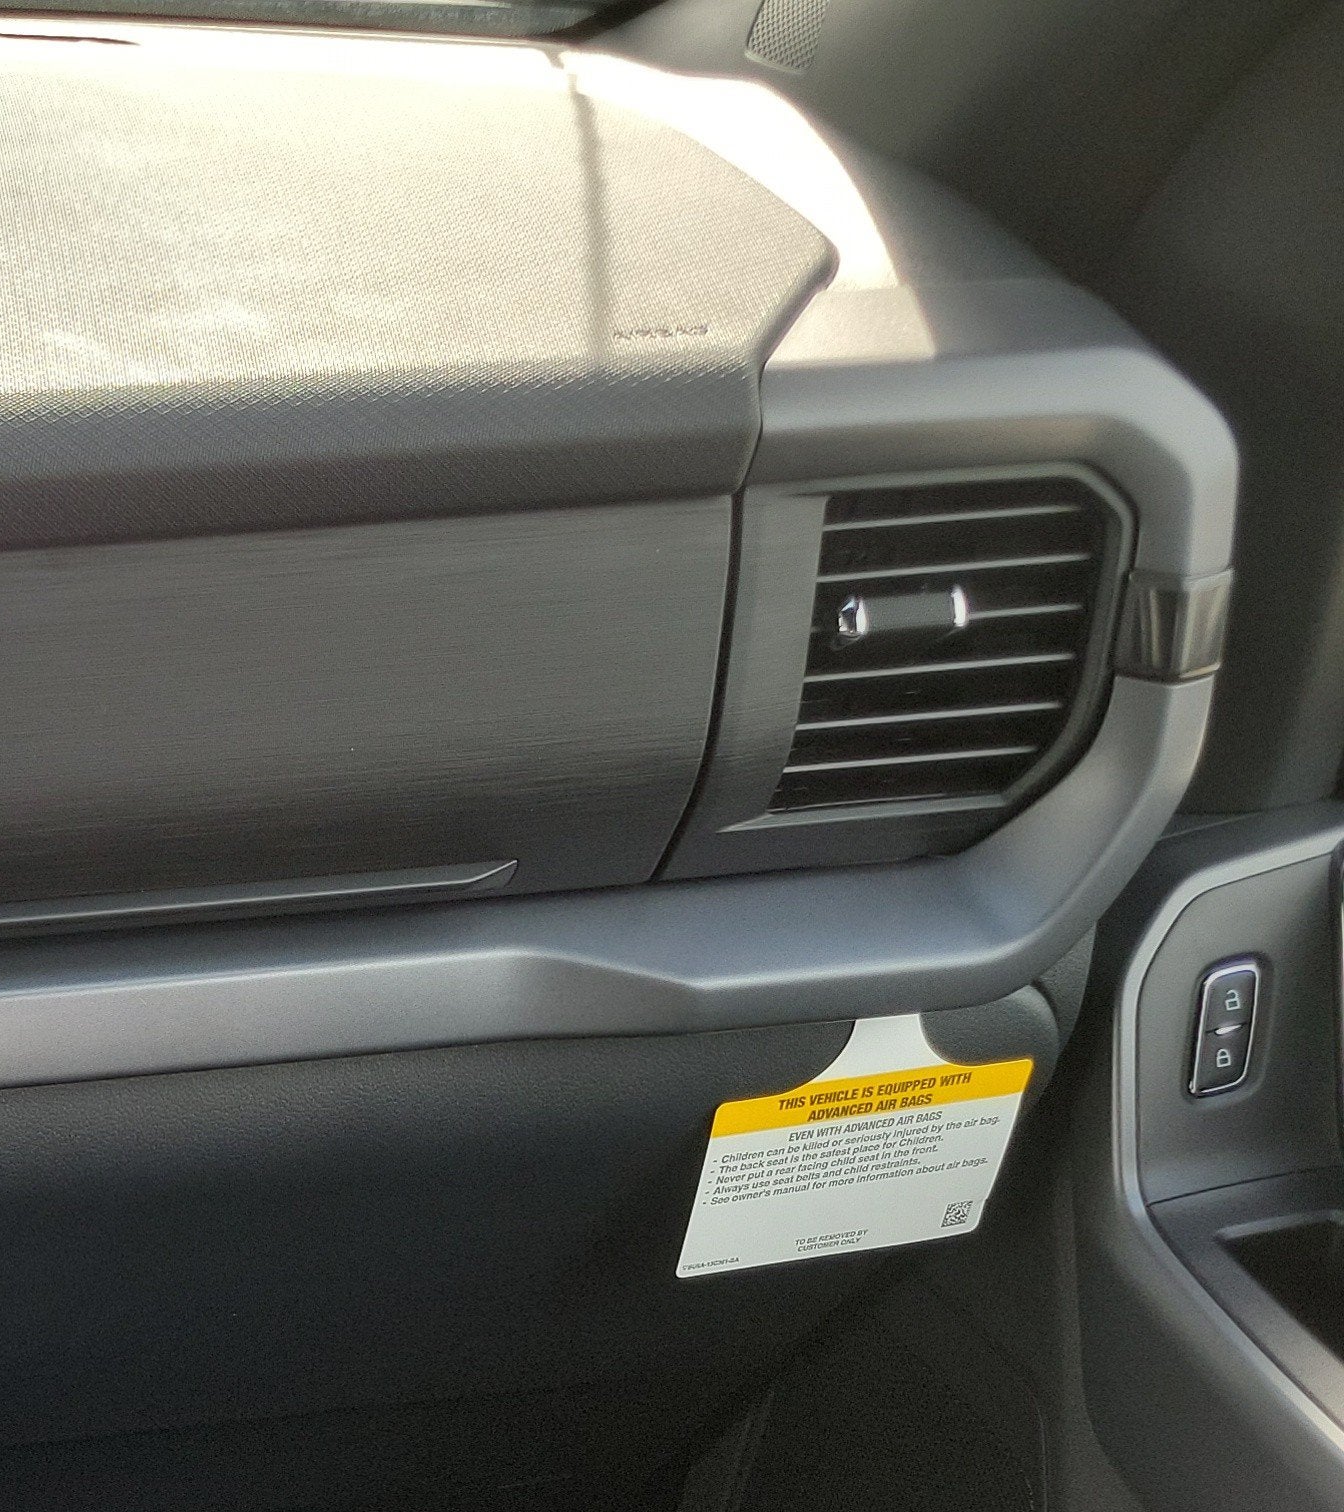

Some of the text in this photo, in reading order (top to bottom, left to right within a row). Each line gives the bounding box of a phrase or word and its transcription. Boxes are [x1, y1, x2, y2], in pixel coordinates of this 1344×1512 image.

[778, 1072, 972, 1111] THIS VEHICLE IS EQUIPPED WITH
[807, 1093, 933, 1122] ADVANCED AIR BAGS
[721, 1151, 764, 1164] Children
[766, 1148, 785, 1156] can
[787, 1143, 800, 1153] be
[802, 1139, 829, 1151] killed
[832, 1139, 843, 1147] or
[844, 1130, 891, 1145] seriously
[893, 1124, 928, 1139] injured
[930, 1122, 944, 1133] by
[946, 1120, 962, 1131] the
[963, 1117, 978, 1128] air
[788, 1110, 943, 1142] EVEN WITH ADVANCED AIR BAGS
[715, 1175, 746, 1185] Never
[747, 1171, 765, 1182] put
[774, 1166, 796, 1176] rear
[797, 1160, 828, 1174] facing
[830, 1154, 856, 1167] child
[857, 1152, 879, 1163] seat
[881, 1150, 891, 1160] in
[893, 1148, 909, 1158] the
[912, 1144, 939, 1155] front.
[719, 1134, 944, 1174] The back seat is the safest place for Children.
[710, 1156, 988, 1205] See owner's manual for more information about air bags.
[713, 1157, 921, 1196] Always use seat belts and child restraints.
[795, 1238, 806, 1246] TO
[819, 1231, 856, 1242] REMOVED
[797, 1237, 863, 1252] CUSTOMER ONLY
